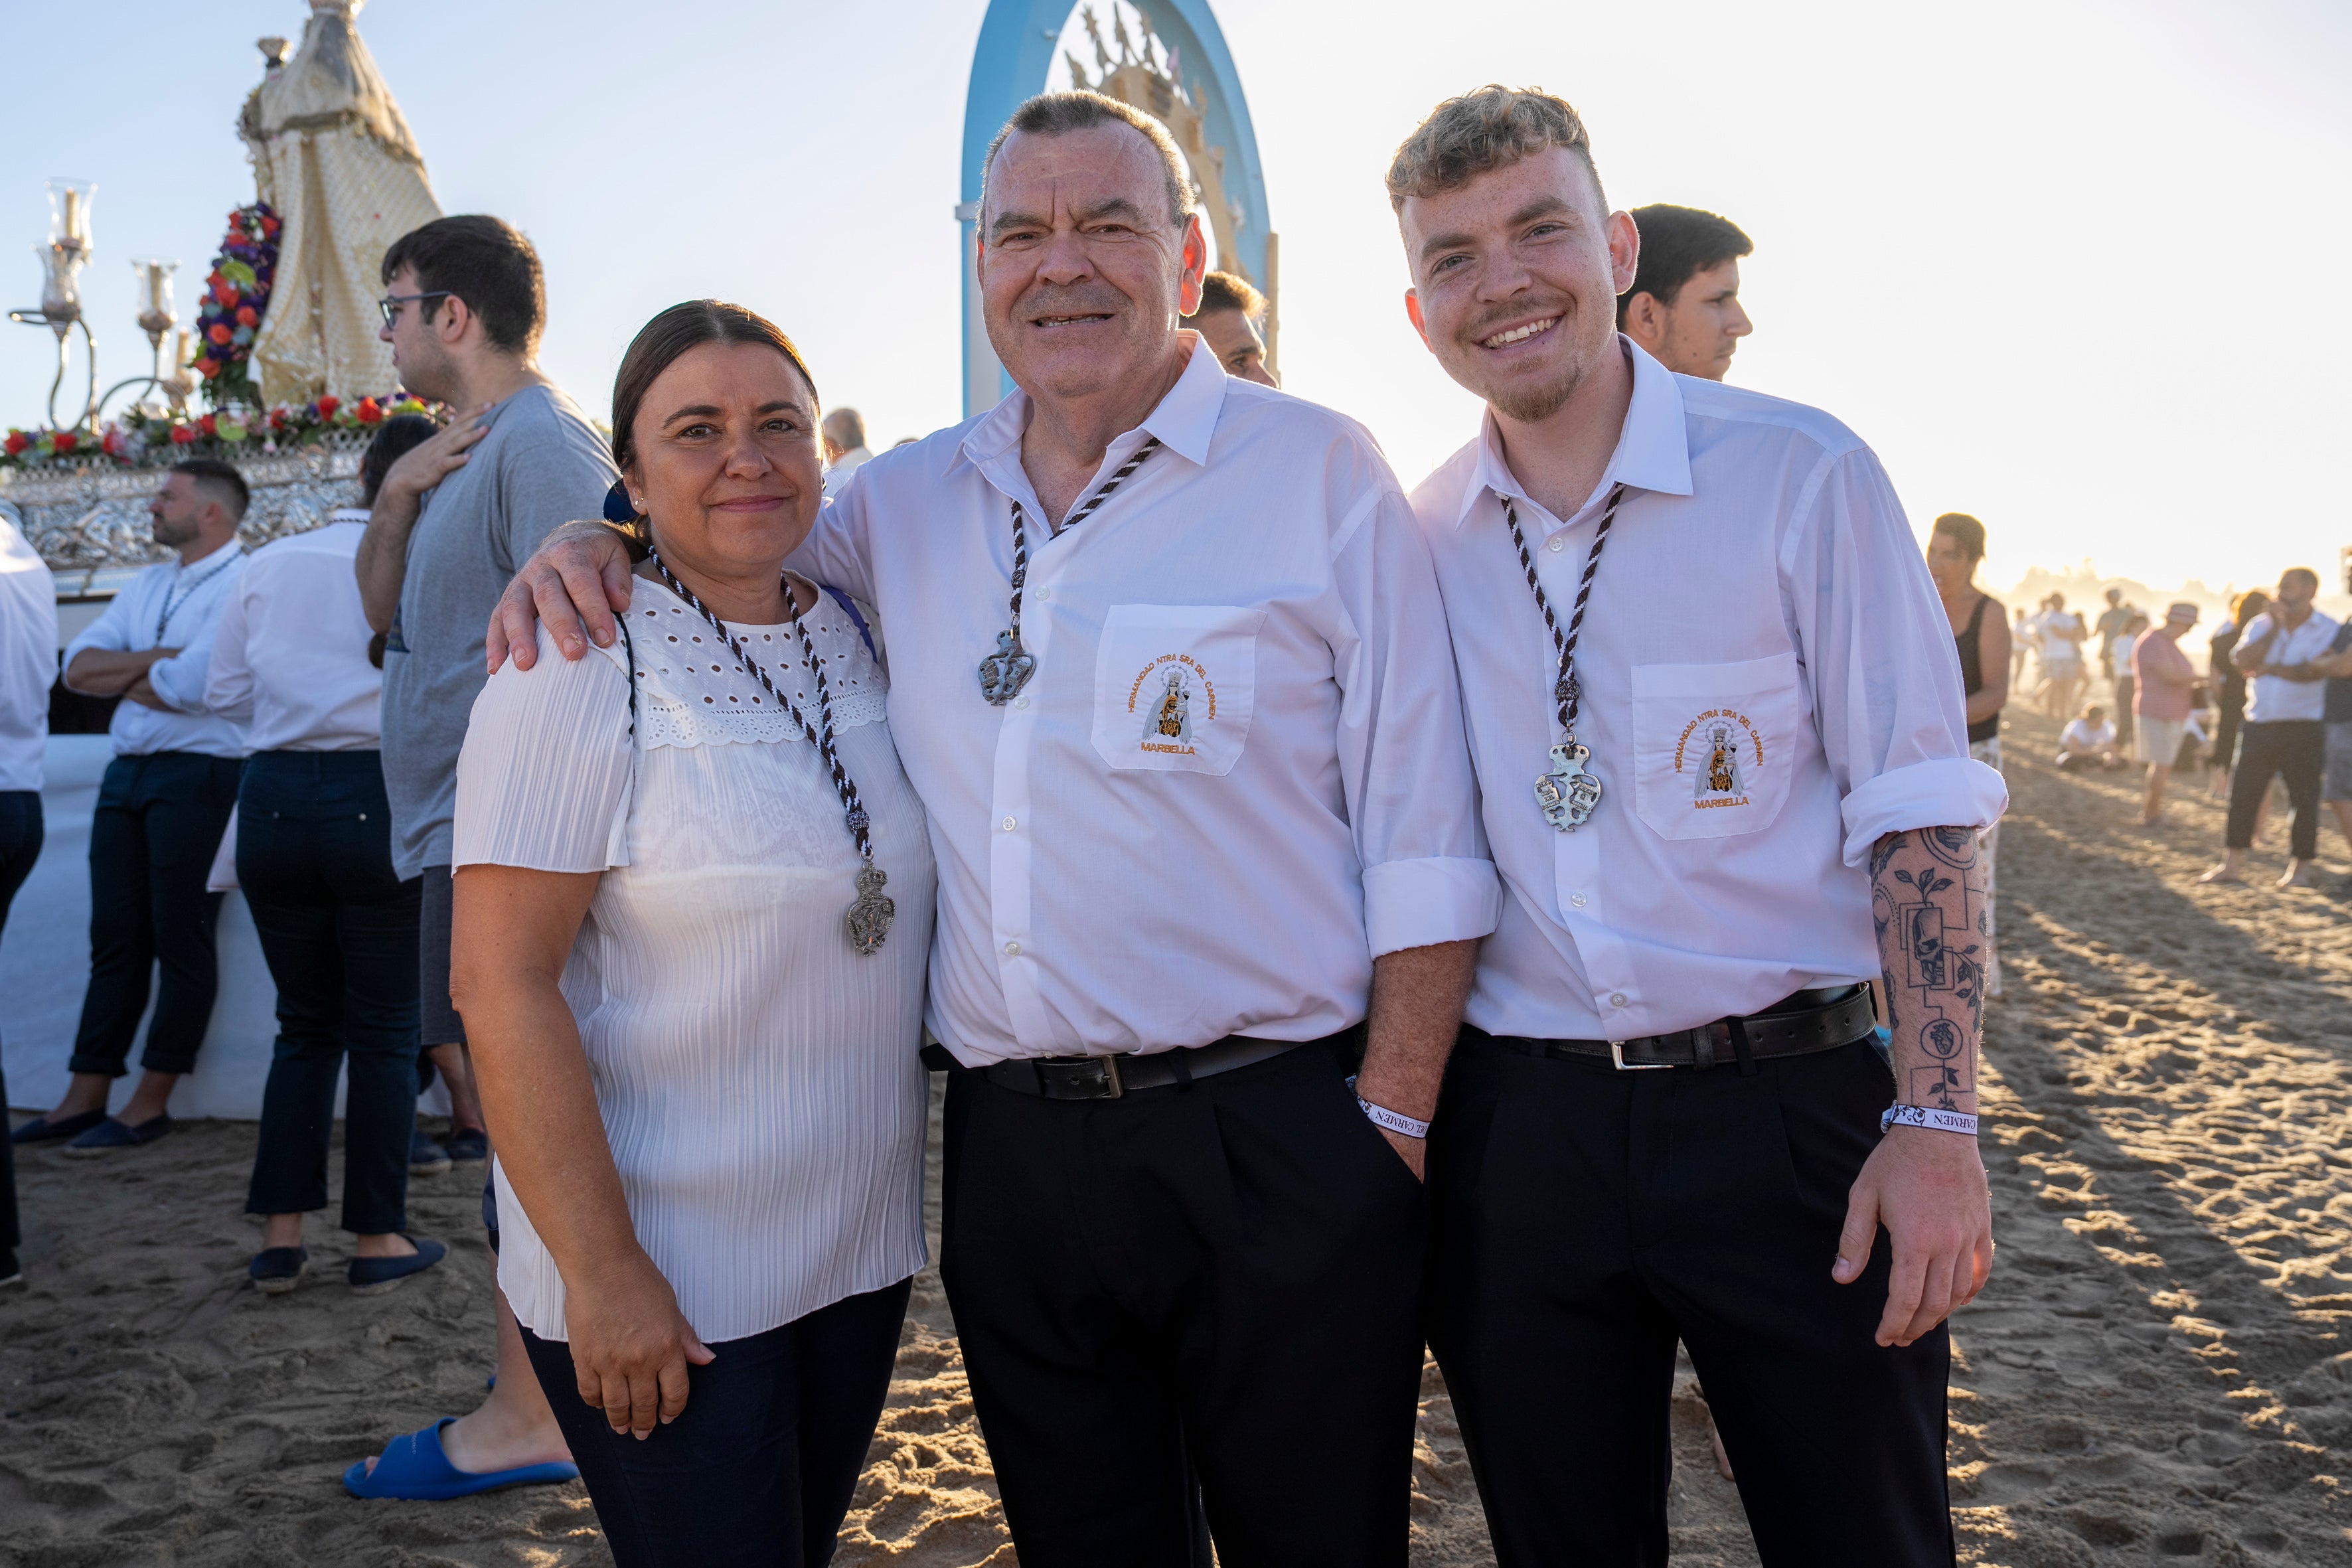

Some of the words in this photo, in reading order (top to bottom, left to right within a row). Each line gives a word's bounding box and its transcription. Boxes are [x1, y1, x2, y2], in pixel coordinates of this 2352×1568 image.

[1128, 663, 1154, 714] HERMANDAD
[1156, 653, 1176, 665] NTRA
[1179, 654, 1194, 667] SRA
[1194, 663, 1208, 680] DEL
[1204, 681, 1216, 720] CARMEN
[1141, 742, 1196, 755] MARBELLA
[1676, 720, 1697, 773] HERMANDAD
[1697, 709, 1719, 723] NTRA
[1721, 709, 1737, 720] SRA
[1738, 714, 1752, 730] DEL
[1751, 730, 1763, 767] CARMEN
[1694, 796, 1749, 809] MARBELLA
[1375, 1111, 1415, 1131] CARMEN
[1416, 1124, 1428, 1134] DEL
[1934, 1114, 1976, 1130] CARMEN
